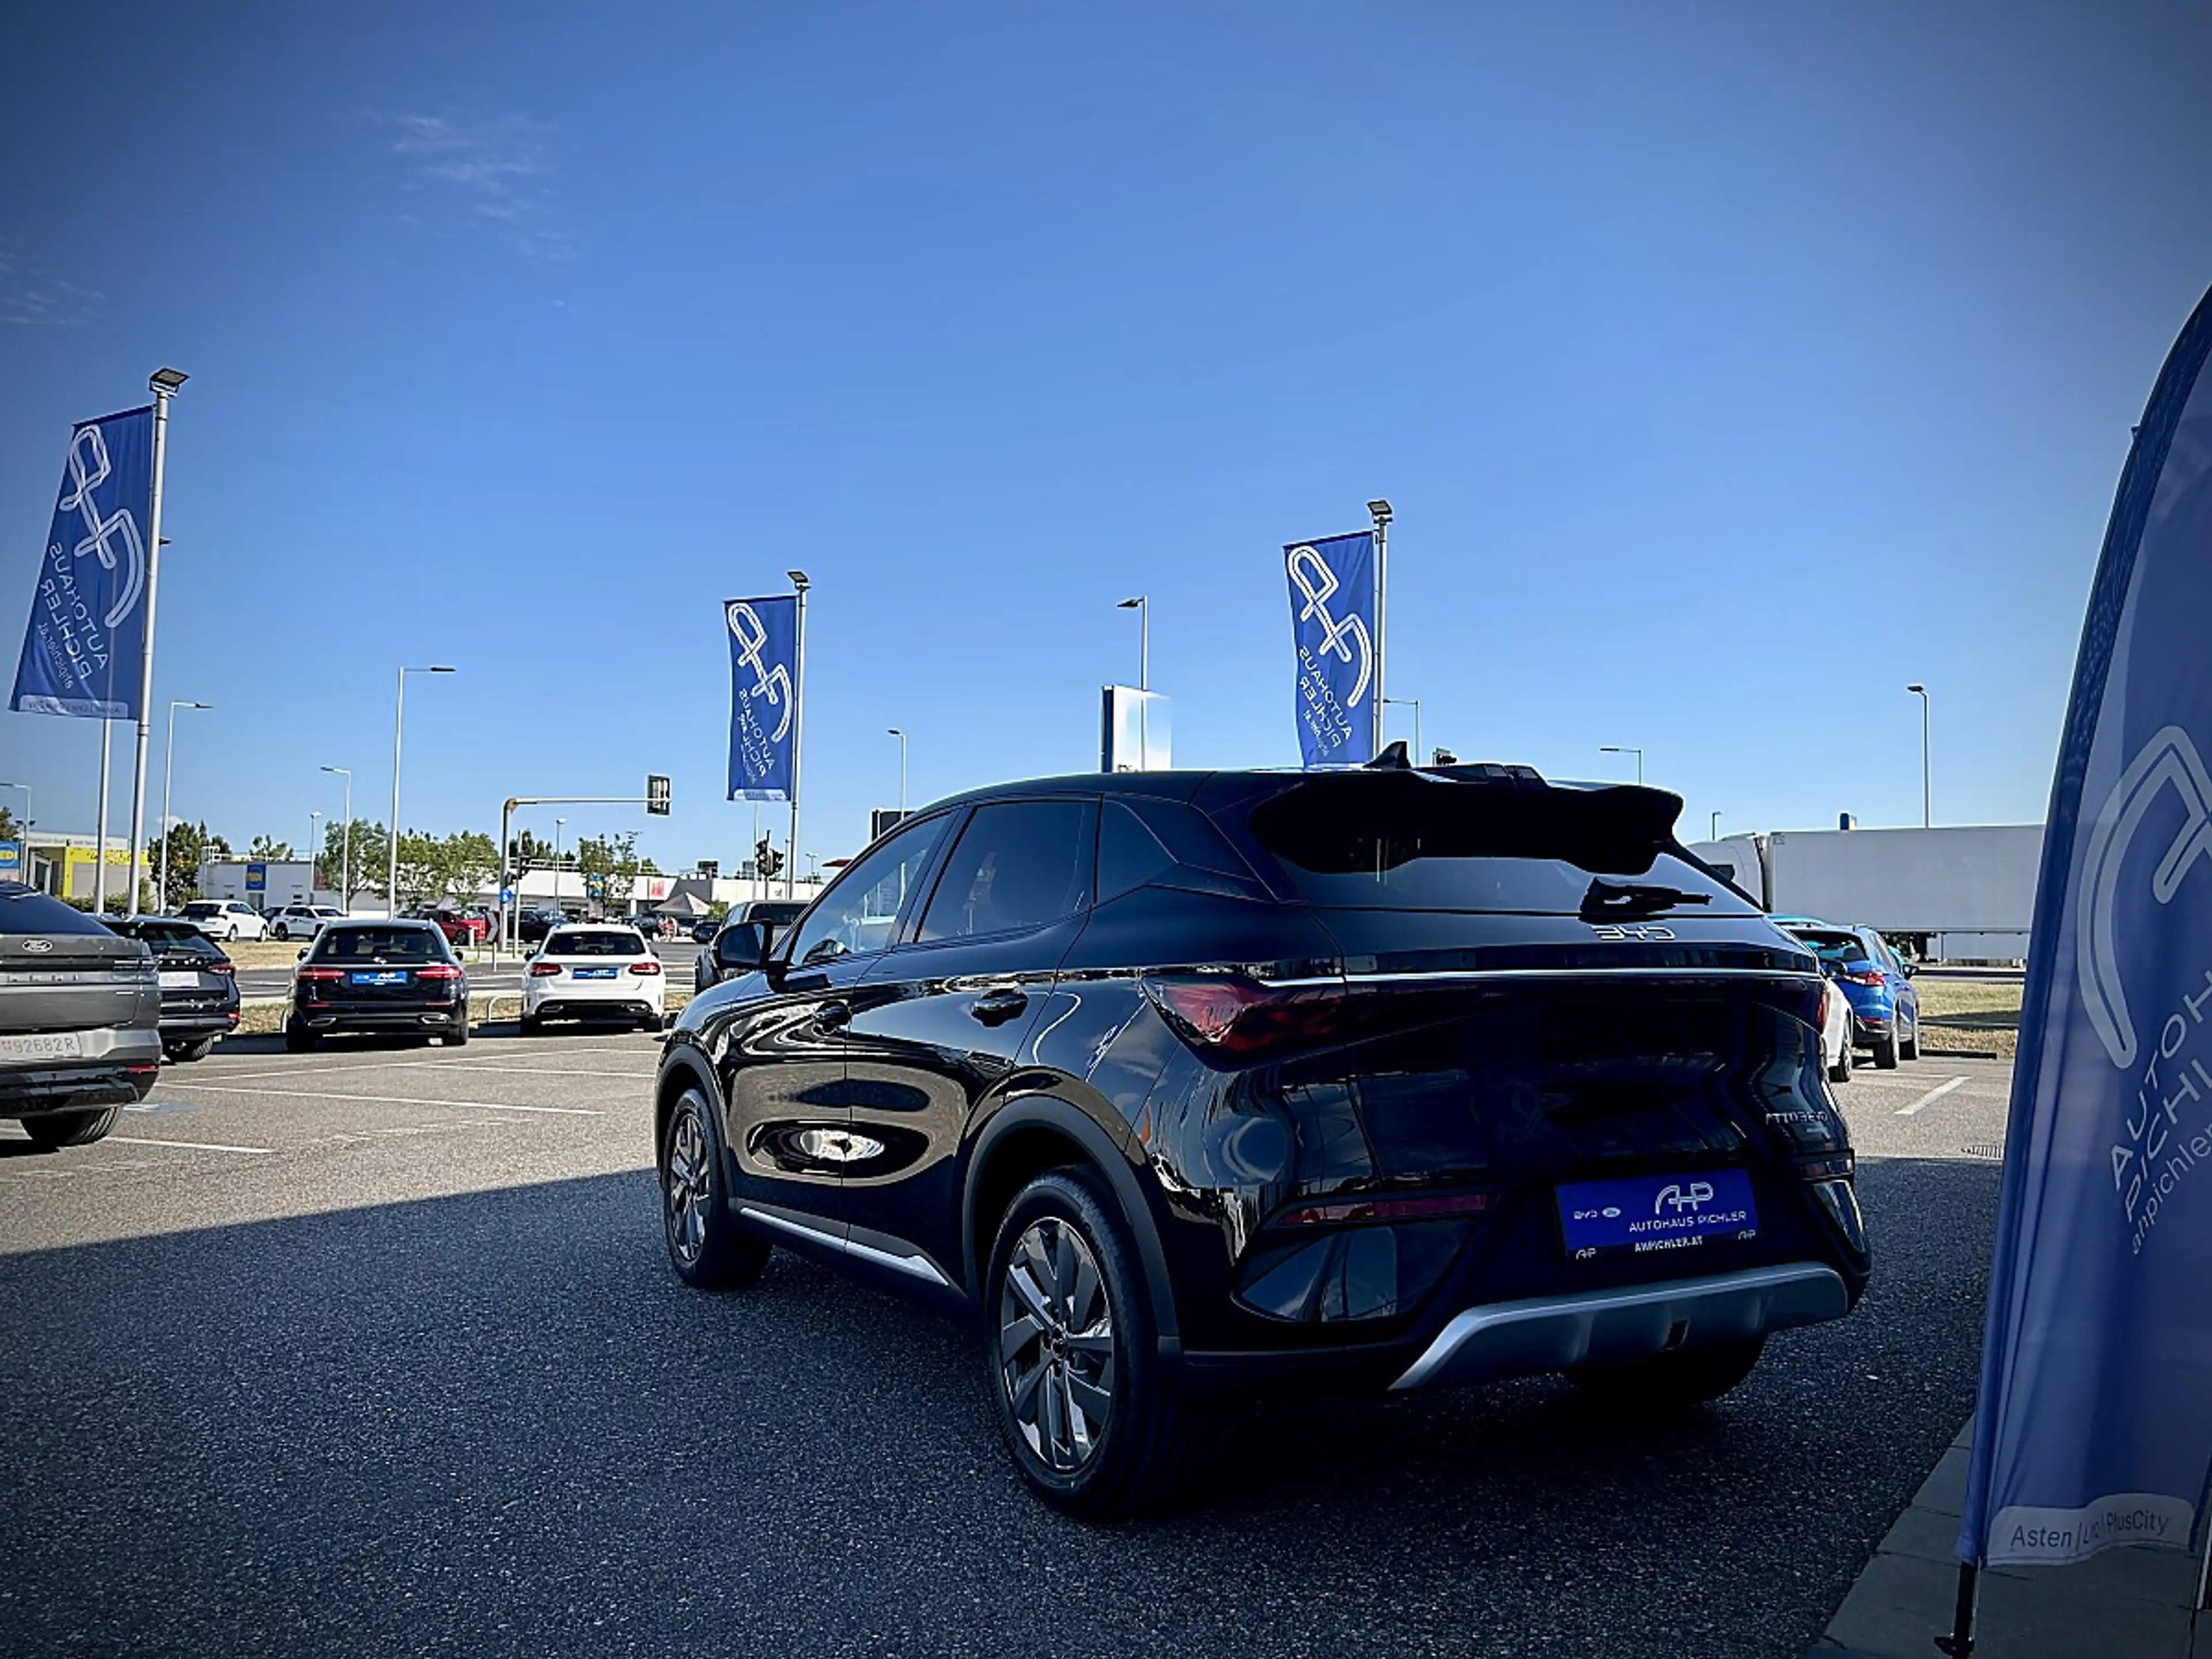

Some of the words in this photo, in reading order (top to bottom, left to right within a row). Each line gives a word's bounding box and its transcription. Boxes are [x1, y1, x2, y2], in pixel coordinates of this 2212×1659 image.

[1629, 1216, 1695, 1233] AUTOHAUS
[1697, 1210, 1747, 1225] PICHLER
[2010, 1524, 2072, 1548] Asten
